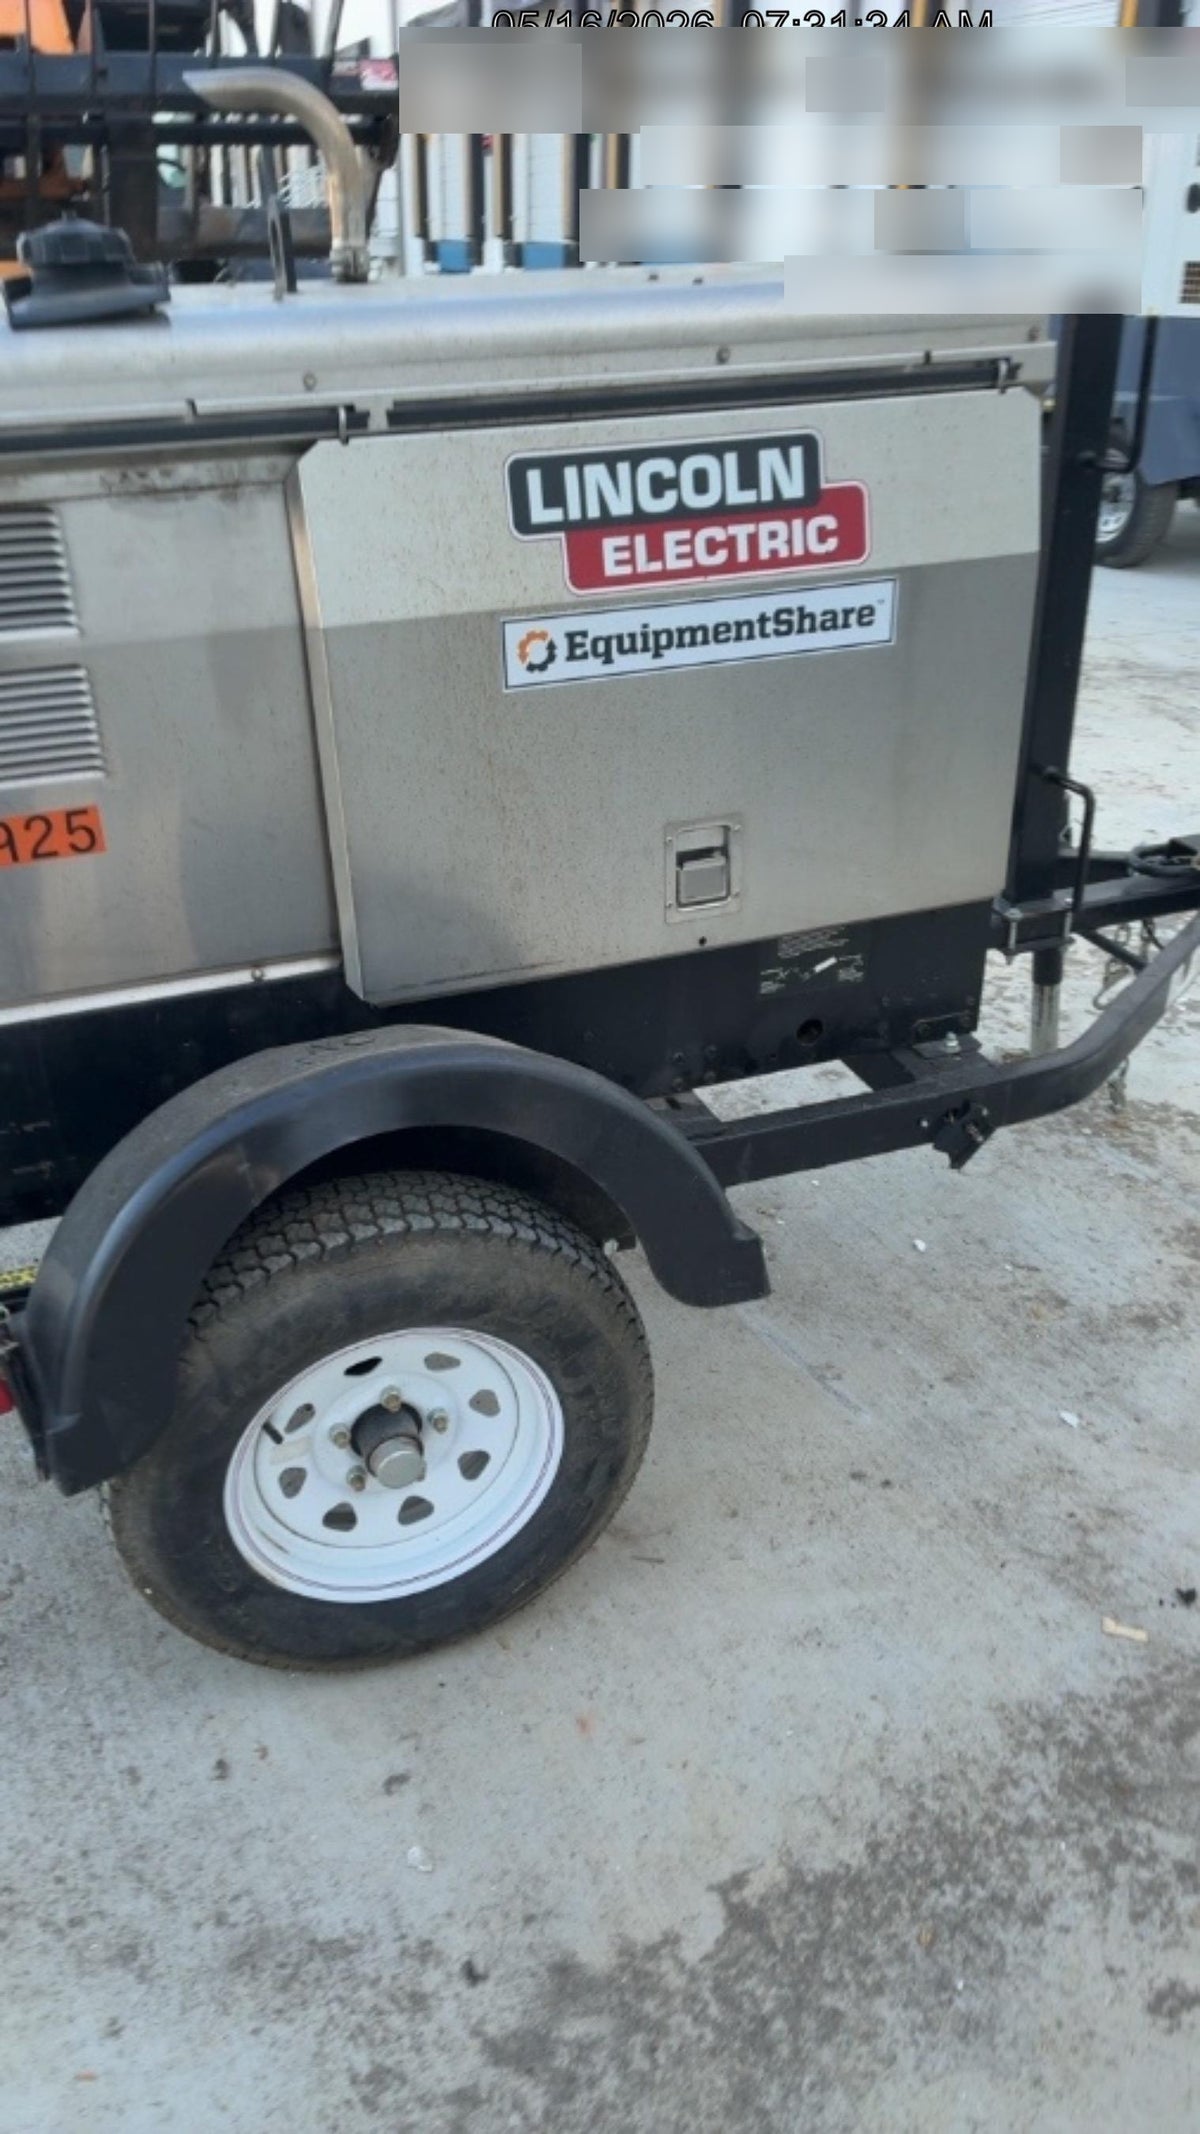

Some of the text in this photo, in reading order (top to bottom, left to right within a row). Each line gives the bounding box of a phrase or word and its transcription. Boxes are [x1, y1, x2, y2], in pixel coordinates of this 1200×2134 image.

[525, 445, 806, 526] LINCOLN
[601, 514, 840, 578] ELECTRIC
[564, 604, 876, 666] EquipmentShare
